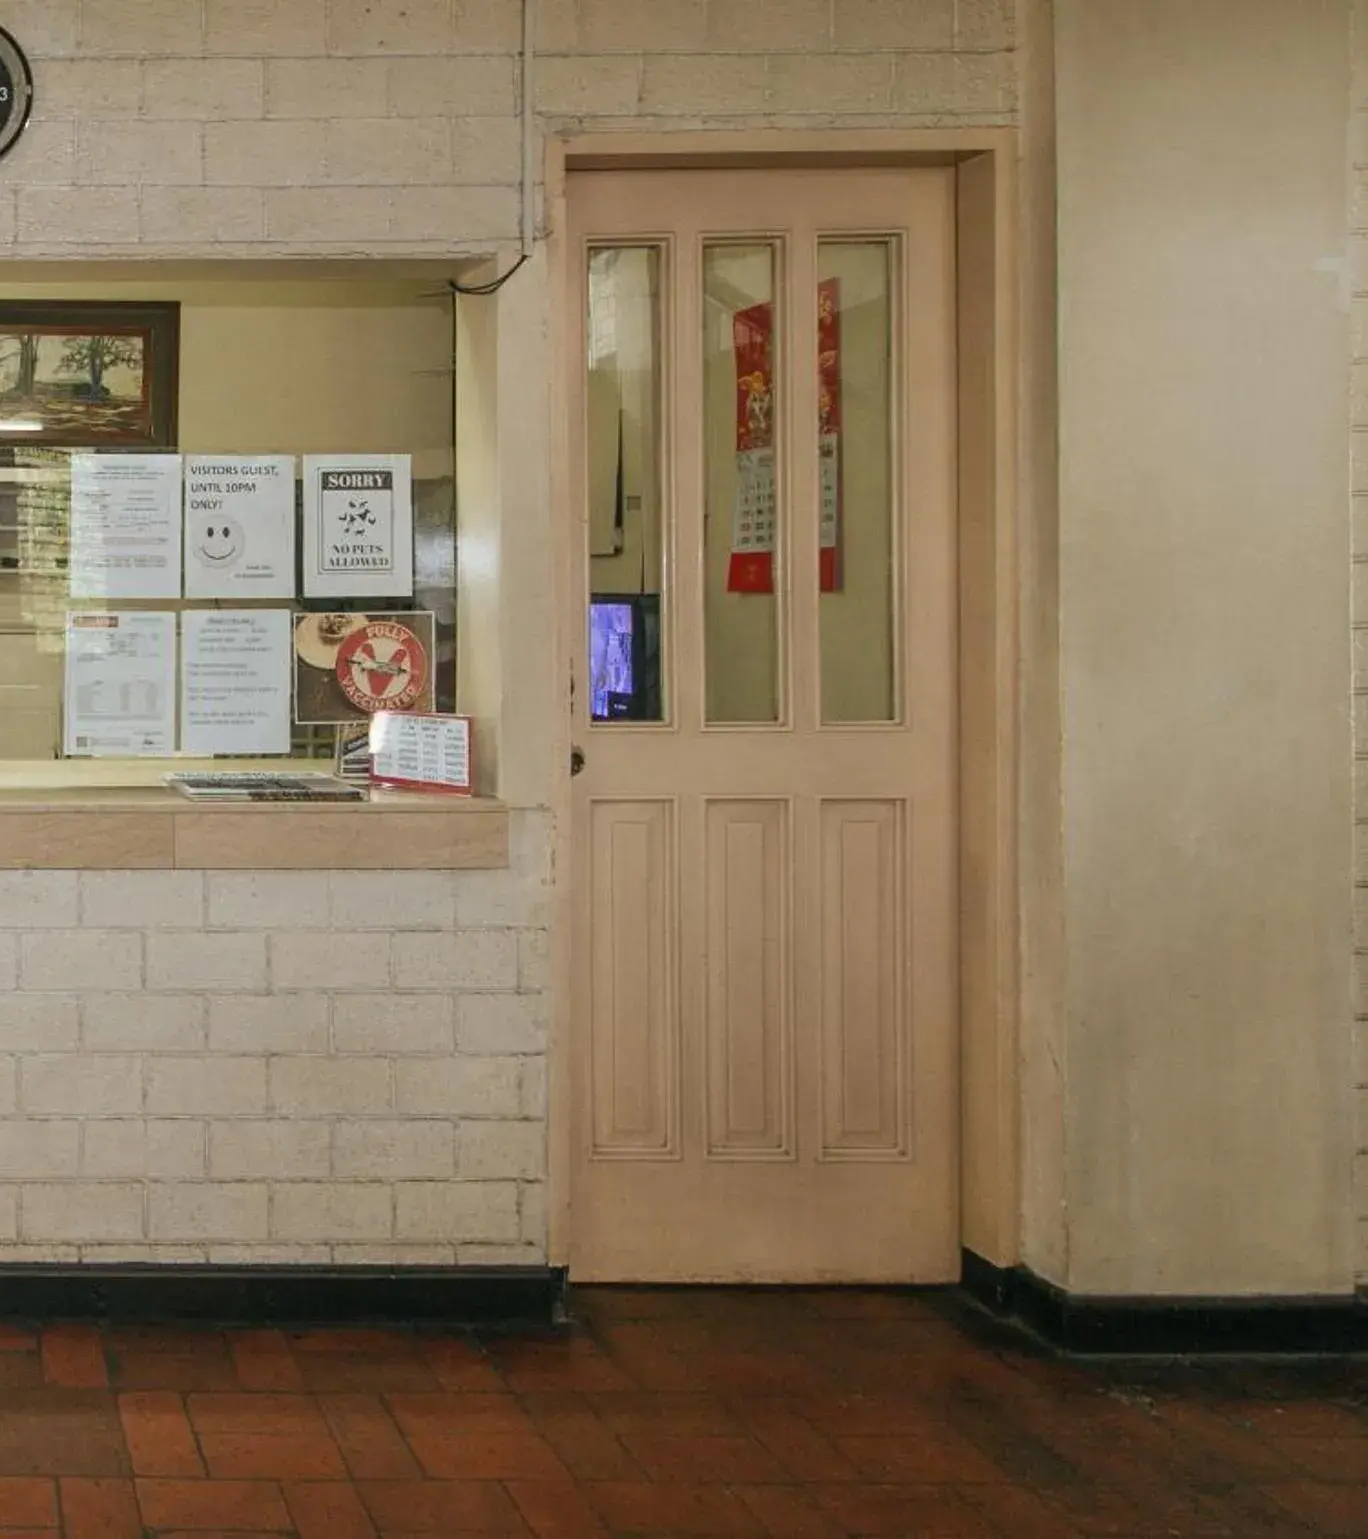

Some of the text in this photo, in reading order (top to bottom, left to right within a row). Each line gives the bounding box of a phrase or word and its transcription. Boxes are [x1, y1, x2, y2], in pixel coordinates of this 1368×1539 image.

[191, 465, 238, 475] VISITORS
[328, 474, 383, 488] SORRY
[191, 482, 256, 494] UNTIL 10PM
[332, 544, 384, 554] NO PETS
[329, 557, 390, 567] ALLOWED
[366, 625, 411, 642] FULLY
[341, 675, 421, 713] VACCINATED
